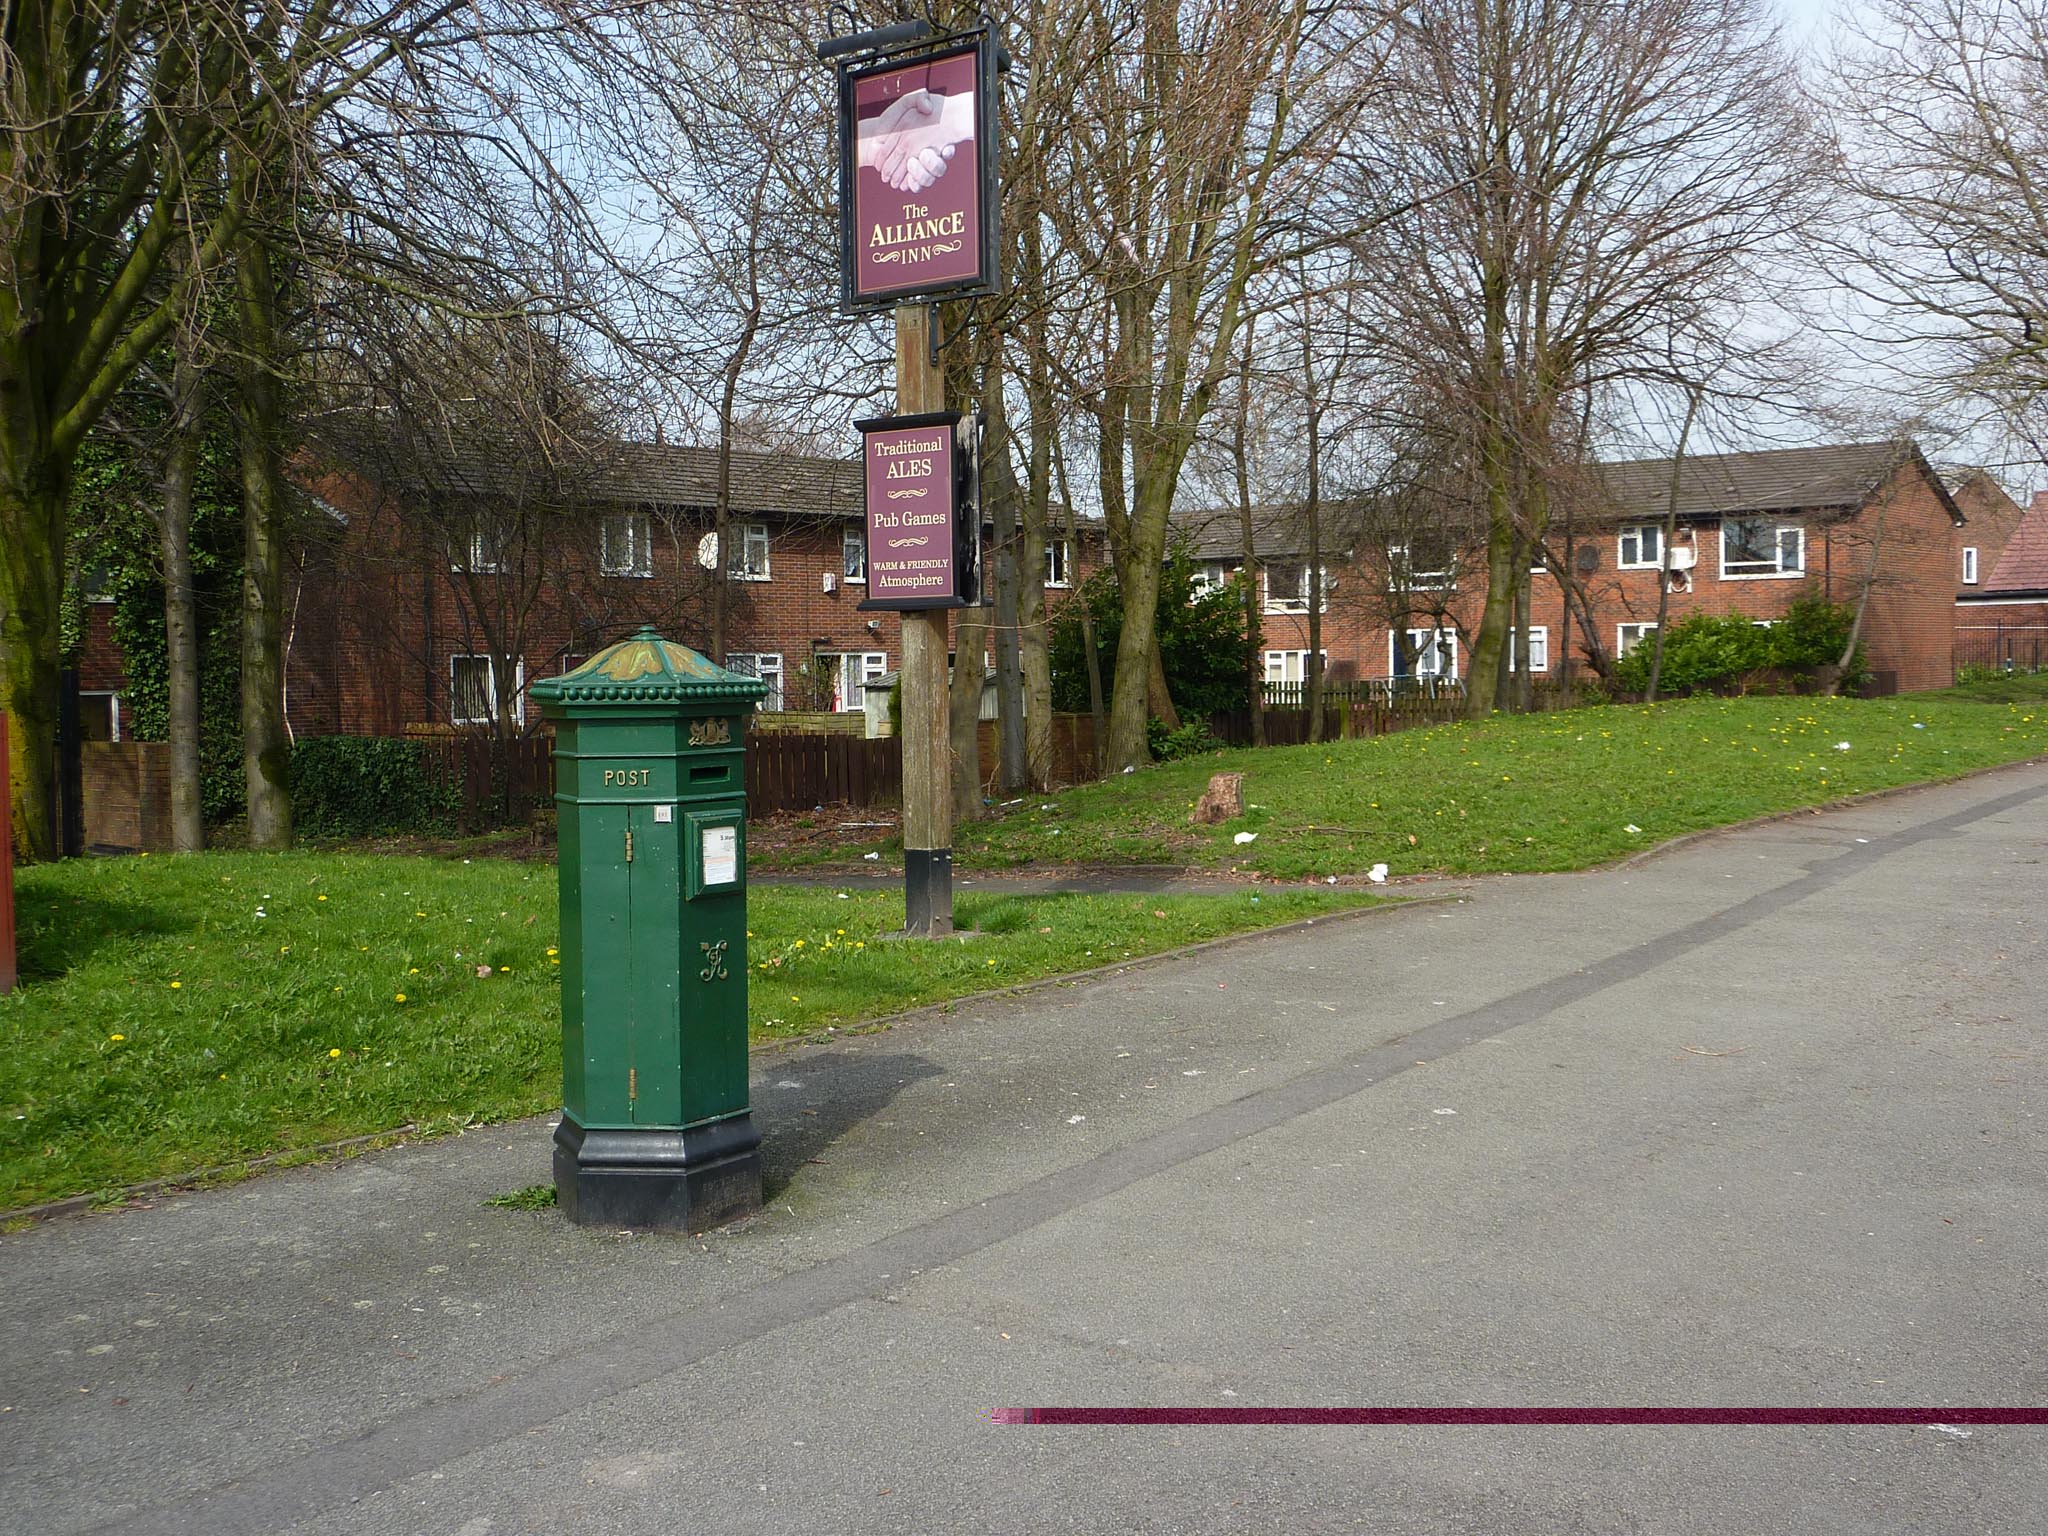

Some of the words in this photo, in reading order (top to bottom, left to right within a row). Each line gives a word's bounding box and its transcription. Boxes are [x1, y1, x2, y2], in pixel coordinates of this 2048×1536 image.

[902, 203, 929, 220] The
[869, 211, 965, 247] ALLIANCE
[901, 245, 932, 264] INN
[874, 436, 943, 457] Traditional
[886, 458, 932, 479] ALES
[873, 512, 899, 529] Pub
[902, 511, 946, 527] Games
[873, 560, 898, 572] WARM
[899, 560, 906, 570] &
[907, 558, 949, 570] FRIENDLY
[878, 572, 944, 590] Atmosphere
[604, 769, 650, 787] POST
